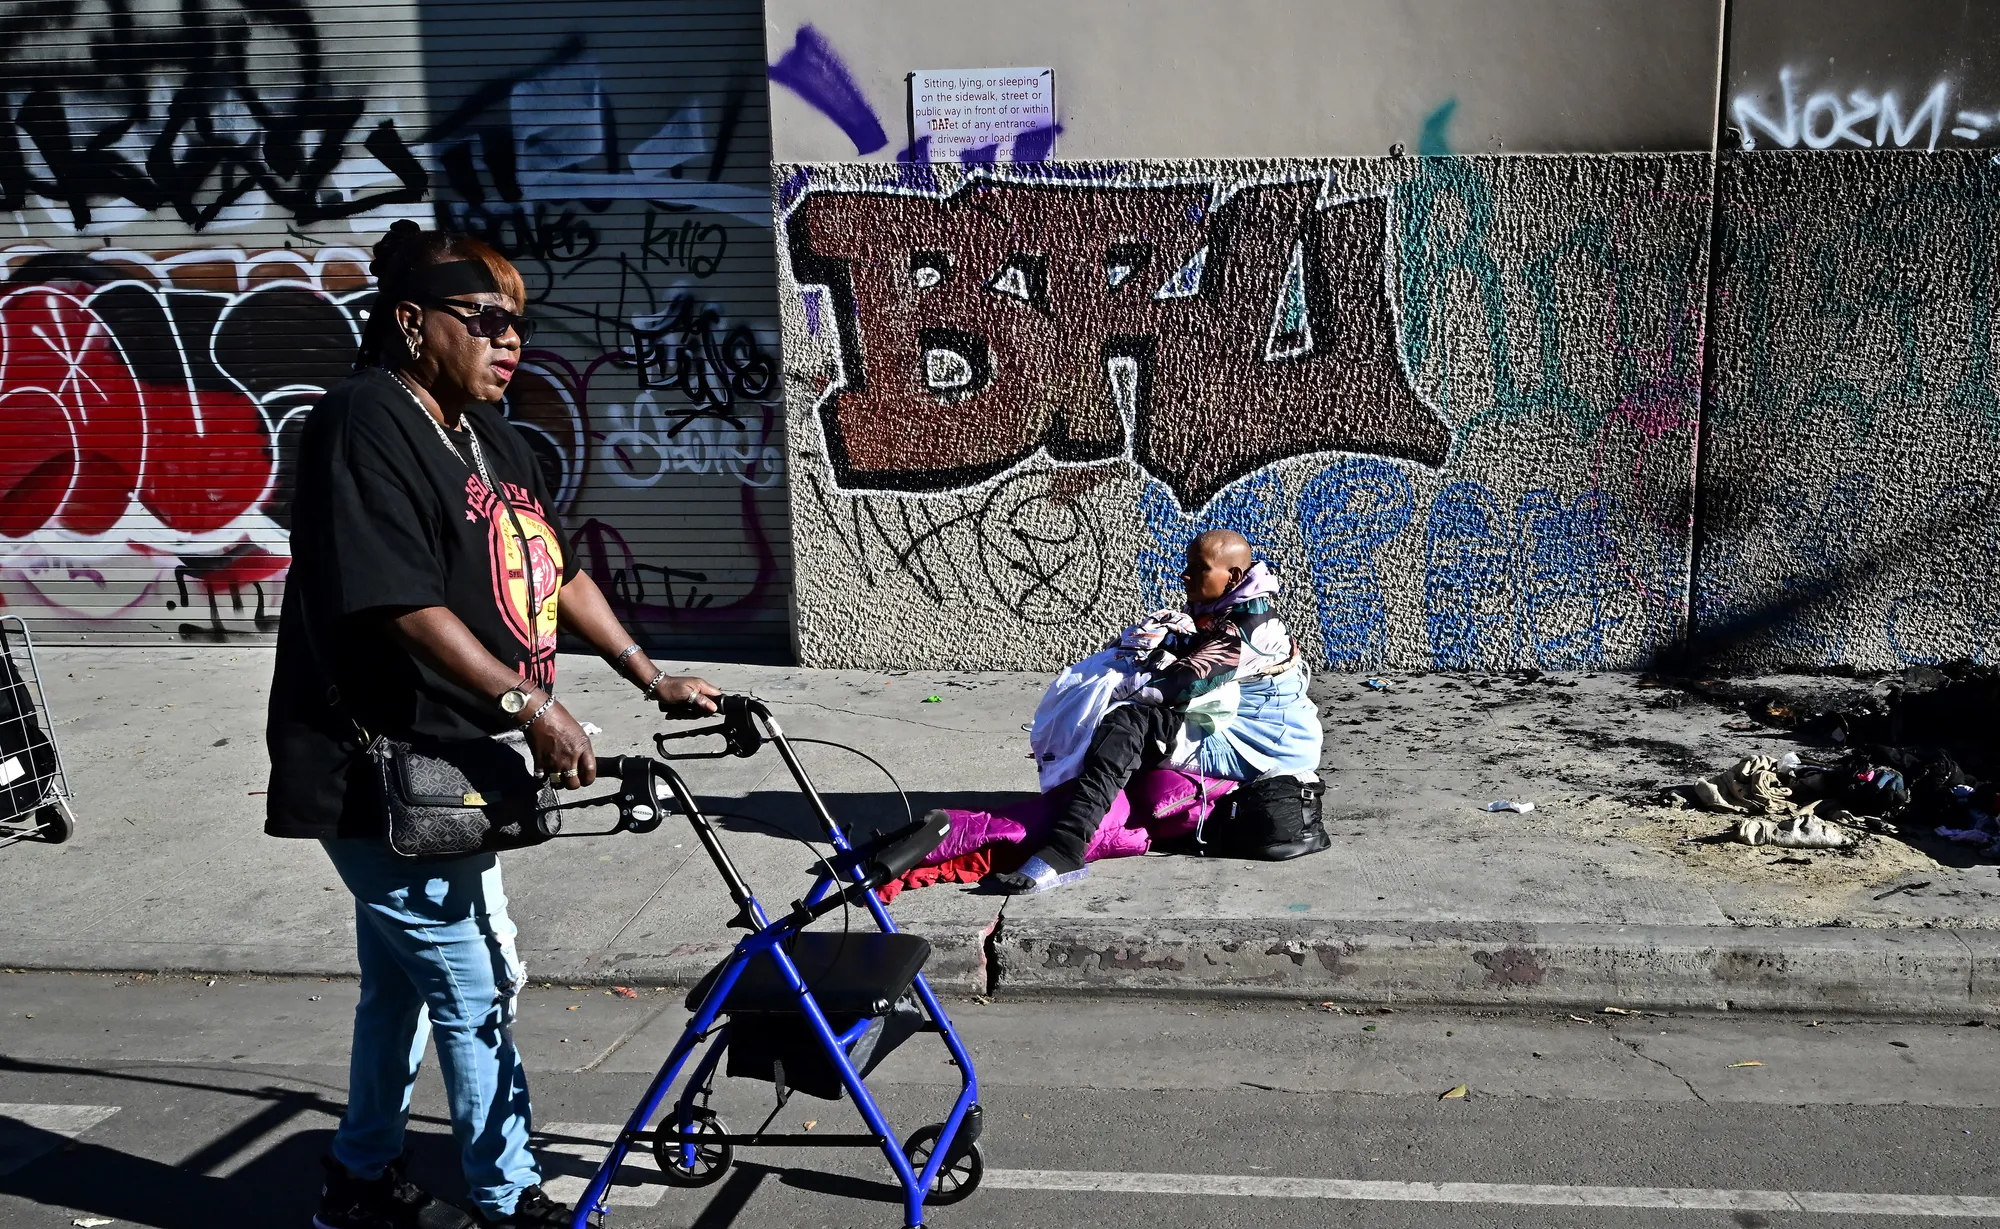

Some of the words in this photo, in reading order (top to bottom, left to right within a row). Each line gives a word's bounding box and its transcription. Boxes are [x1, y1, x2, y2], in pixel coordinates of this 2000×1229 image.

[924, 78, 957, 89] Sitting,
[959, 78, 984, 89] lying,
[999, 76, 1039, 88] sleeping
[921, 95, 934, 103] on
[936, 93, 952, 102] the
[955, 91, 998, 102] sidewalk,
[1001, 92, 1028, 101] street
[1031, 92, 1042, 100] or
[915, 108, 942, 118] public
[944, 109, 961, 117] way
[975, 105, 996, 114] front
[998, 104, 1008, 113] of
[1010, 105, 1021, 113] or
[1022, 104, 1050, 113] within
[961, 119, 972, 129] of
[974, 121, 991, 131] any
[994, 118, 1038, 129] entrance,
[937, 133, 977, 145] driveway
[979, 134, 989, 142] or
[930, 148, 947, 157] this
